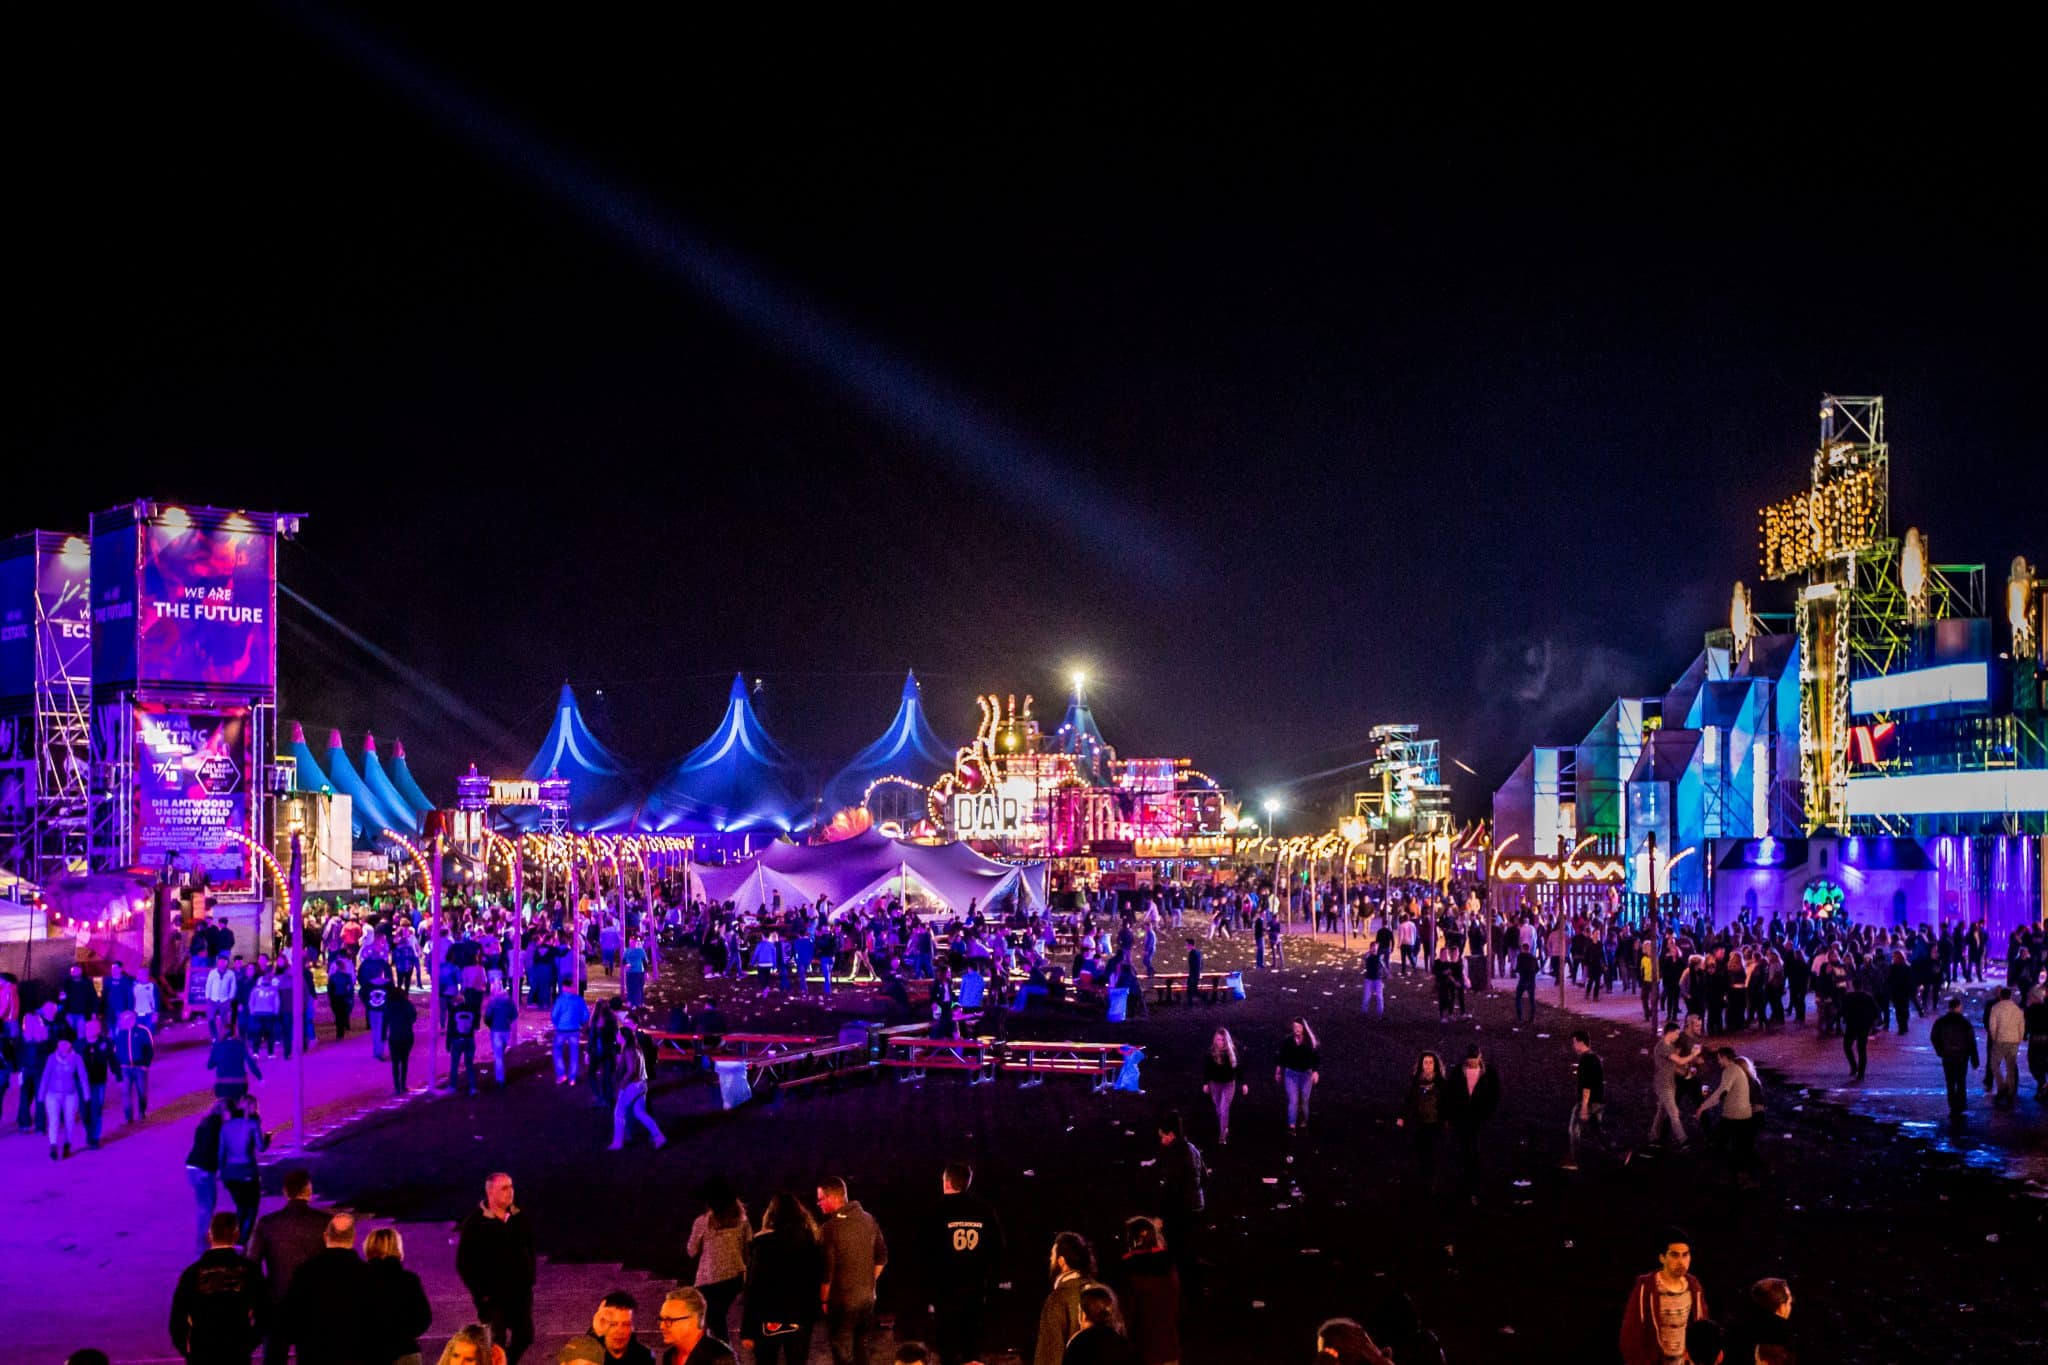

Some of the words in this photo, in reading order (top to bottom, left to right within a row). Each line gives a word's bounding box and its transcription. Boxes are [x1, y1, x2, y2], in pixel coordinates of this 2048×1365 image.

[184, 586, 205, 599] WE
[207, 587, 232, 601] ARE
[152, 601, 190, 619] THE
[194, 604, 263, 623] FUTURE
[136, 729, 208, 743] ETRIC
[151, 799, 169, 807] DIE
[171, 799, 234, 808] ANTWOORD
[155, 808, 230, 816] UNDERWORLD
[159, 816, 198, 824] FATBOY
[200, 817, 226, 825] SLIM
[953, 1229, 979, 1251] 69
